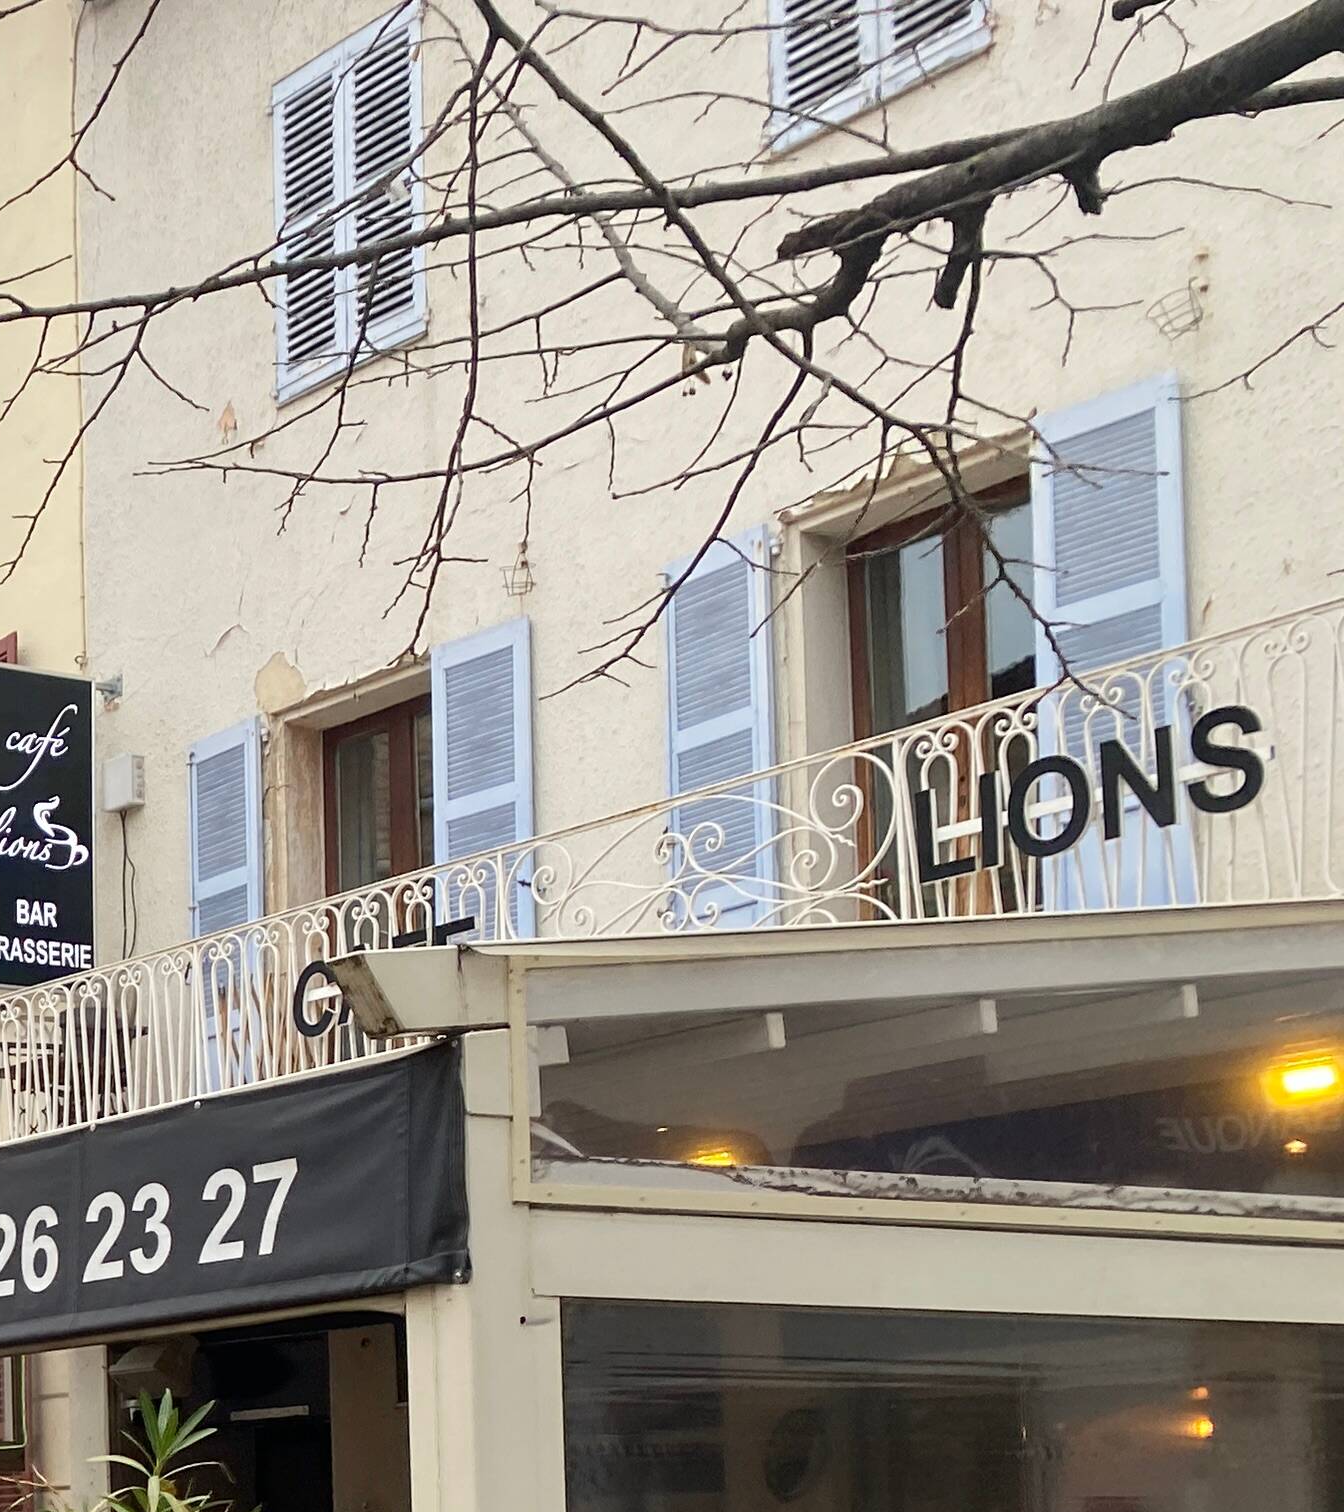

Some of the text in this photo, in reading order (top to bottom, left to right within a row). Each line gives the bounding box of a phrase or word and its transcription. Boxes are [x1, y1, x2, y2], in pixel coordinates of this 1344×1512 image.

[915, 705, 1265, 883] LIONS
[16, 899, 58, 928] BAR
[82, 1182, 172, 1283] 23
[198, 1158, 298, 1265] 27
